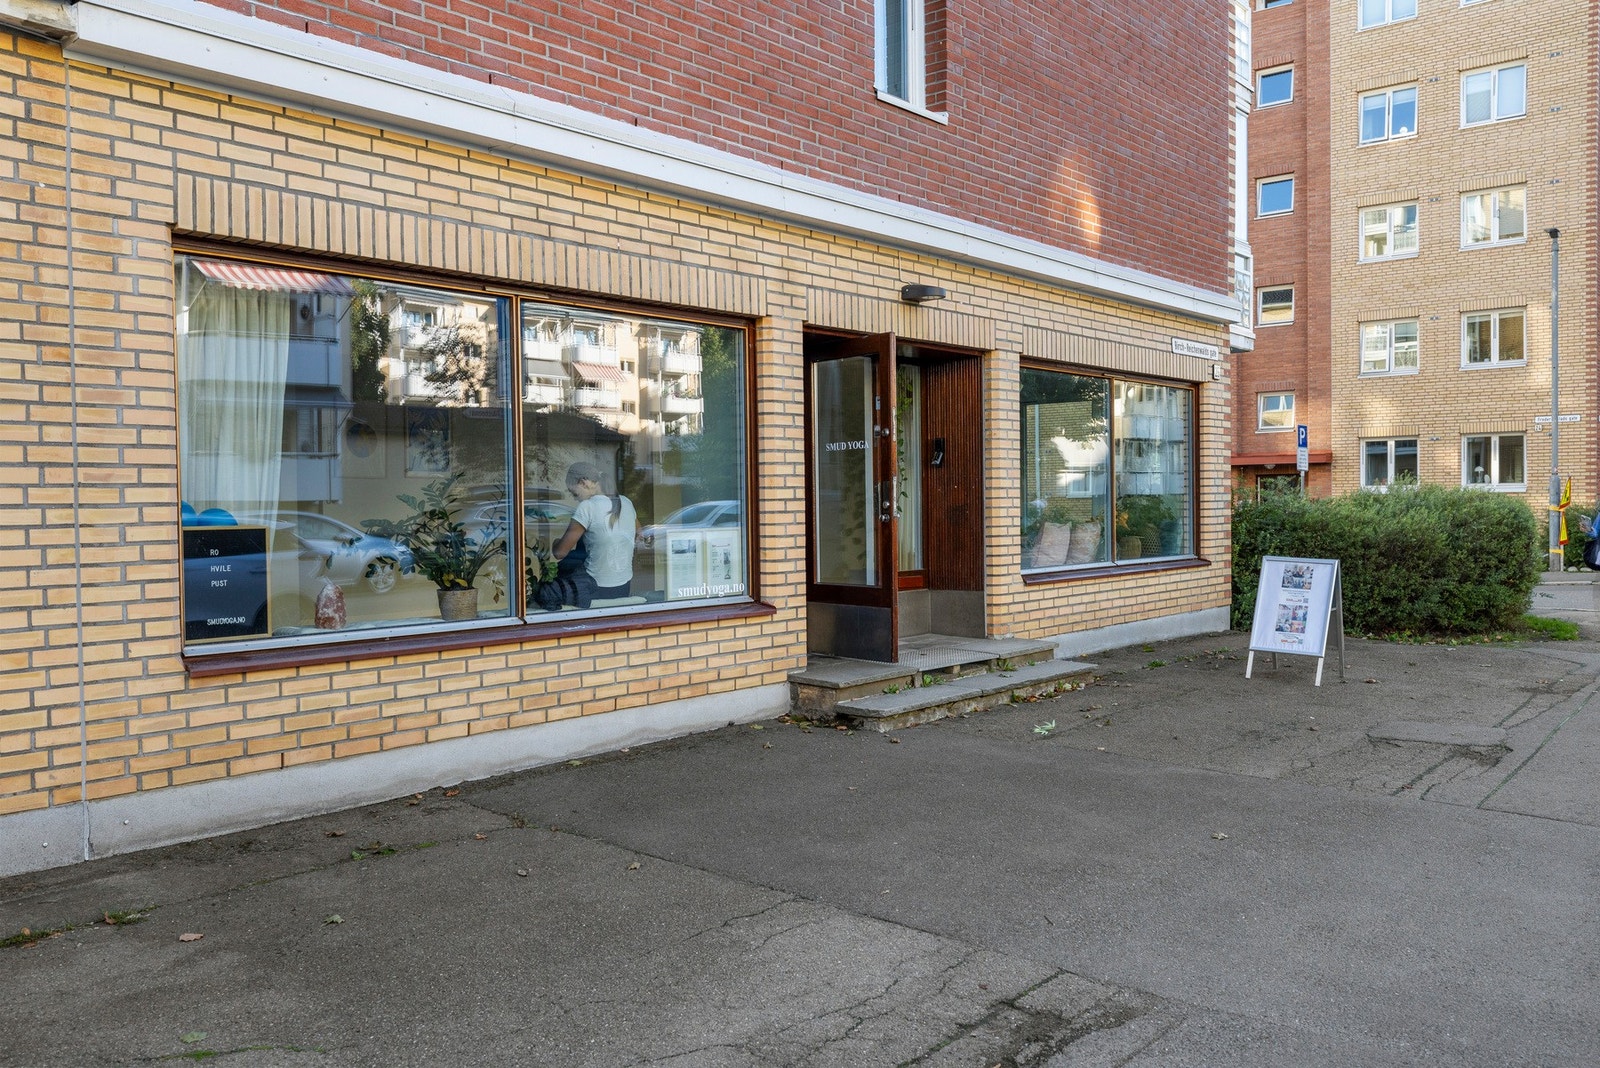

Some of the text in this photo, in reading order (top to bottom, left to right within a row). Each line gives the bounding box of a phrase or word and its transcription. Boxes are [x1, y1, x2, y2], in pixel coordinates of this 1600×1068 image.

[1299, 427, 1306, 445] P
[825, 440, 870, 451] SMUD YOGA
[210, 564, 232, 572] HVILE
[210, 579, 228, 588] PUST
[677, 582, 745, 598] smudyoga.no
